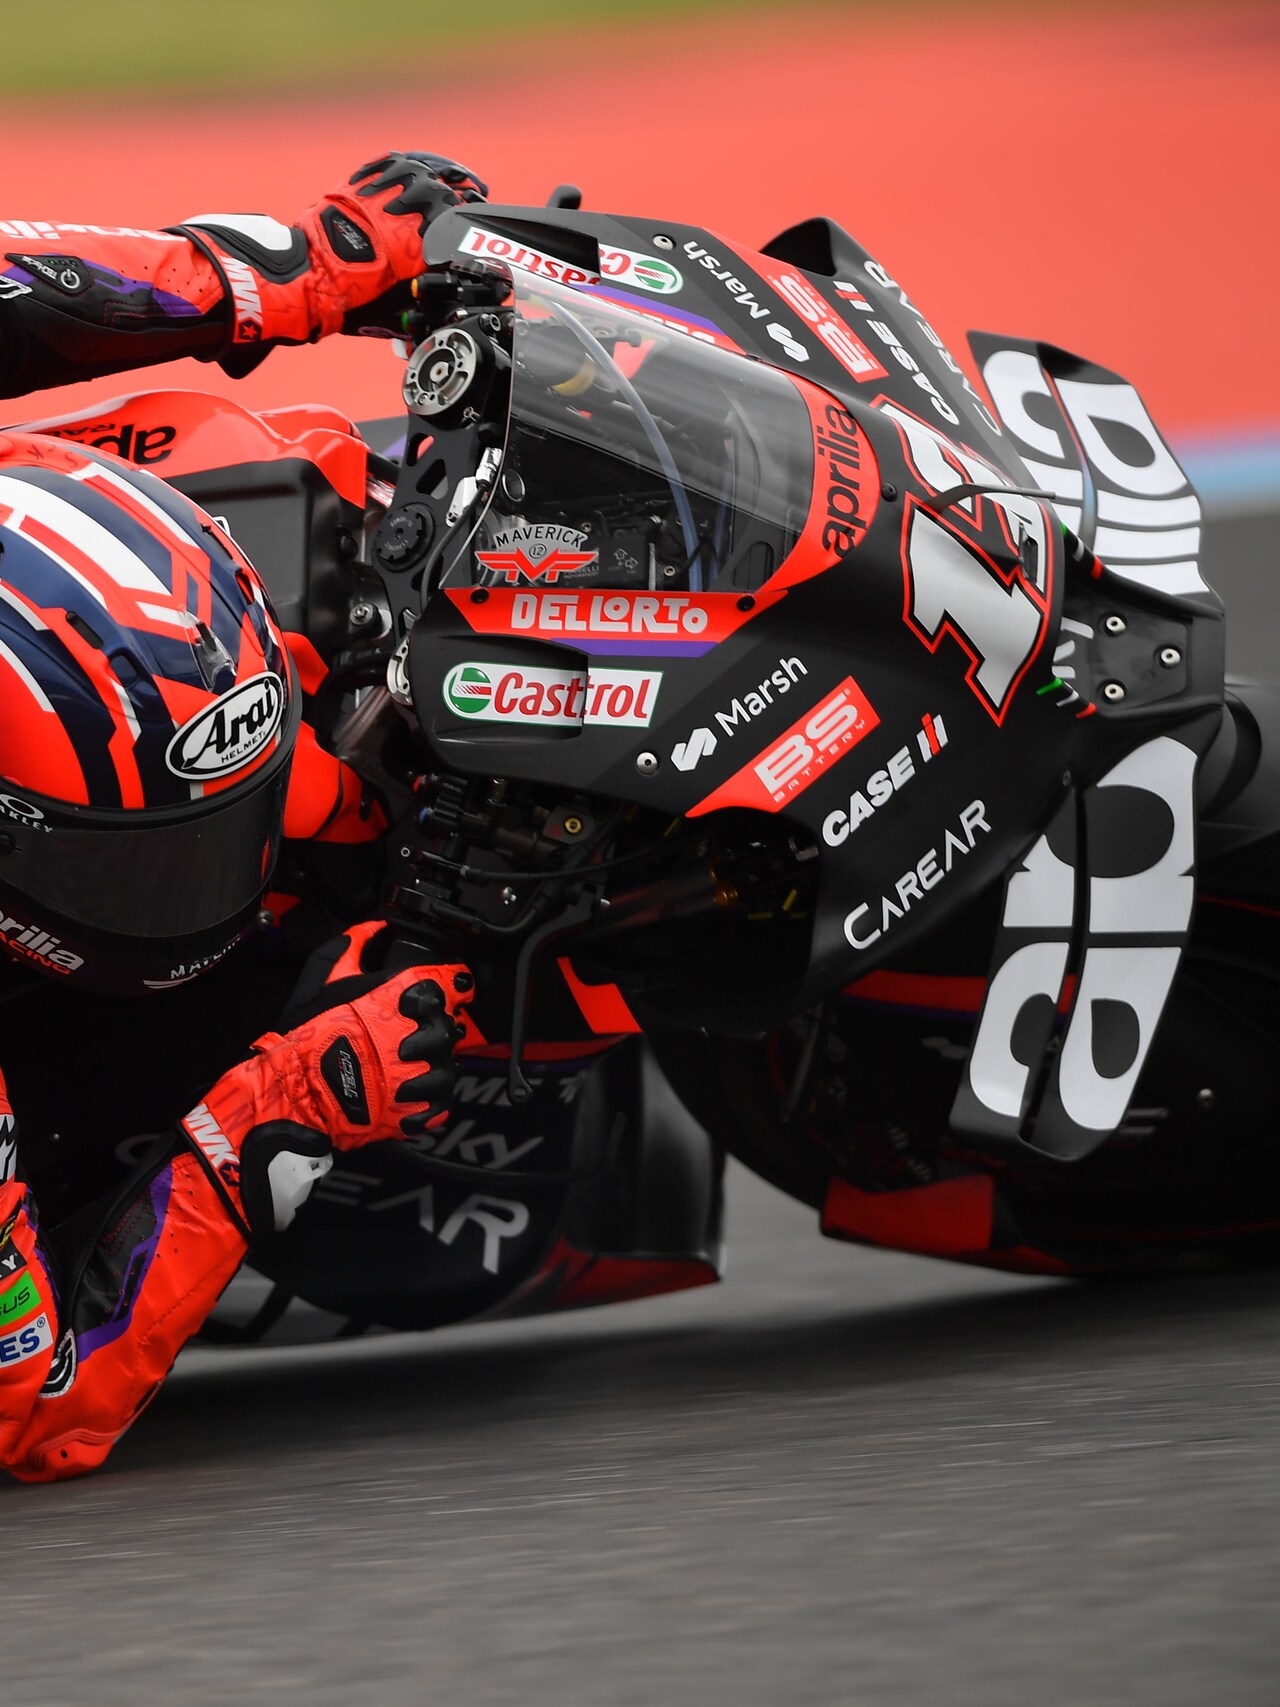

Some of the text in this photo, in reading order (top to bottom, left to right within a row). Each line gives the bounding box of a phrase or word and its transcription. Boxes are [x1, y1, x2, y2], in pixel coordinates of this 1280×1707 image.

[220, 254, 263, 325] MVK
[683, 241, 770, 318] Marsh
[867, 319, 960, 426] CASE
[817, 403, 865, 560] aprilia
[495, 525, 587, 548] MAVERICK
[511, 593, 708, 633] DELLORTO
[181, 678, 276, 770] Arai
[492, 671, 651, 720] Castrol
[715, 656, 809, 737] Marsh
[753, 692, 858, 794] BS
[773, 719, 865, 803] BATTERY
[822, 745, 916, 848] CASE
[842, 799, 993, 950] CAREAR
[185, 1103, 240, 1169] MVK
